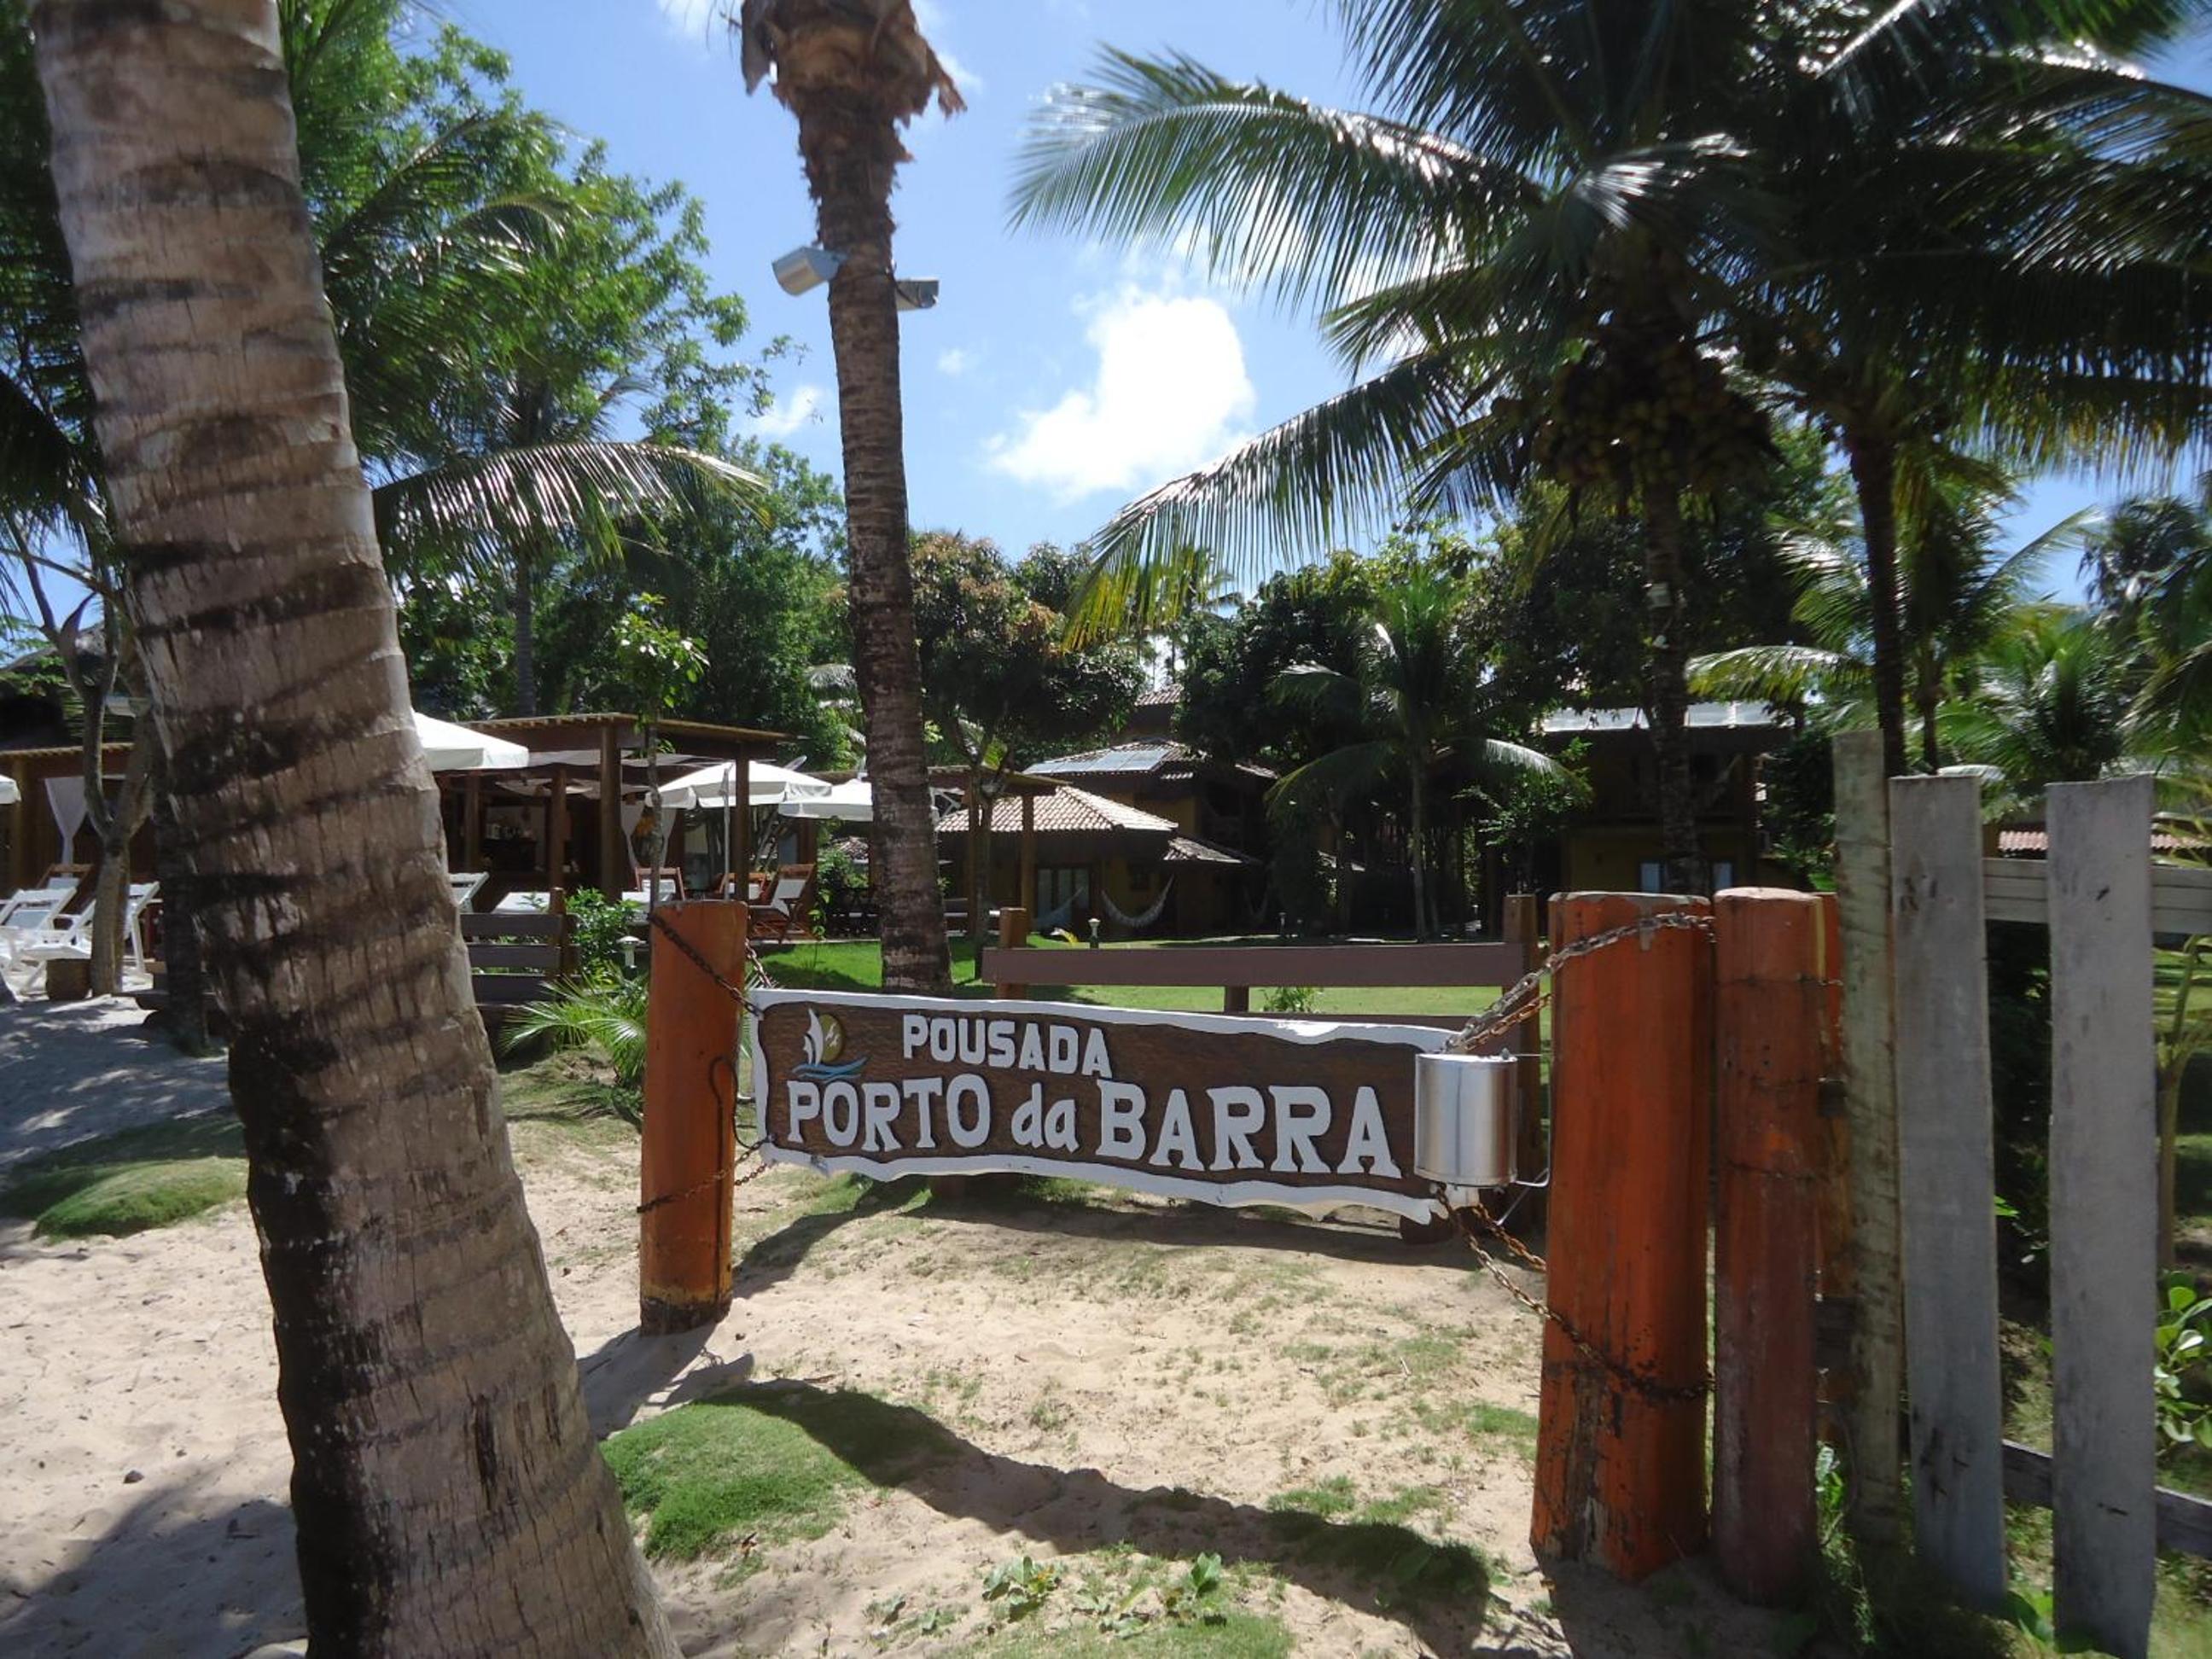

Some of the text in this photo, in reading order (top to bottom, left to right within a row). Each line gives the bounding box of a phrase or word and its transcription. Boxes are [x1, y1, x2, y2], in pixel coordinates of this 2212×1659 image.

[903, 1014, 1113, 1079] POUSADA
[786, 1073, 1402, 1179] PORTO da BARRA
